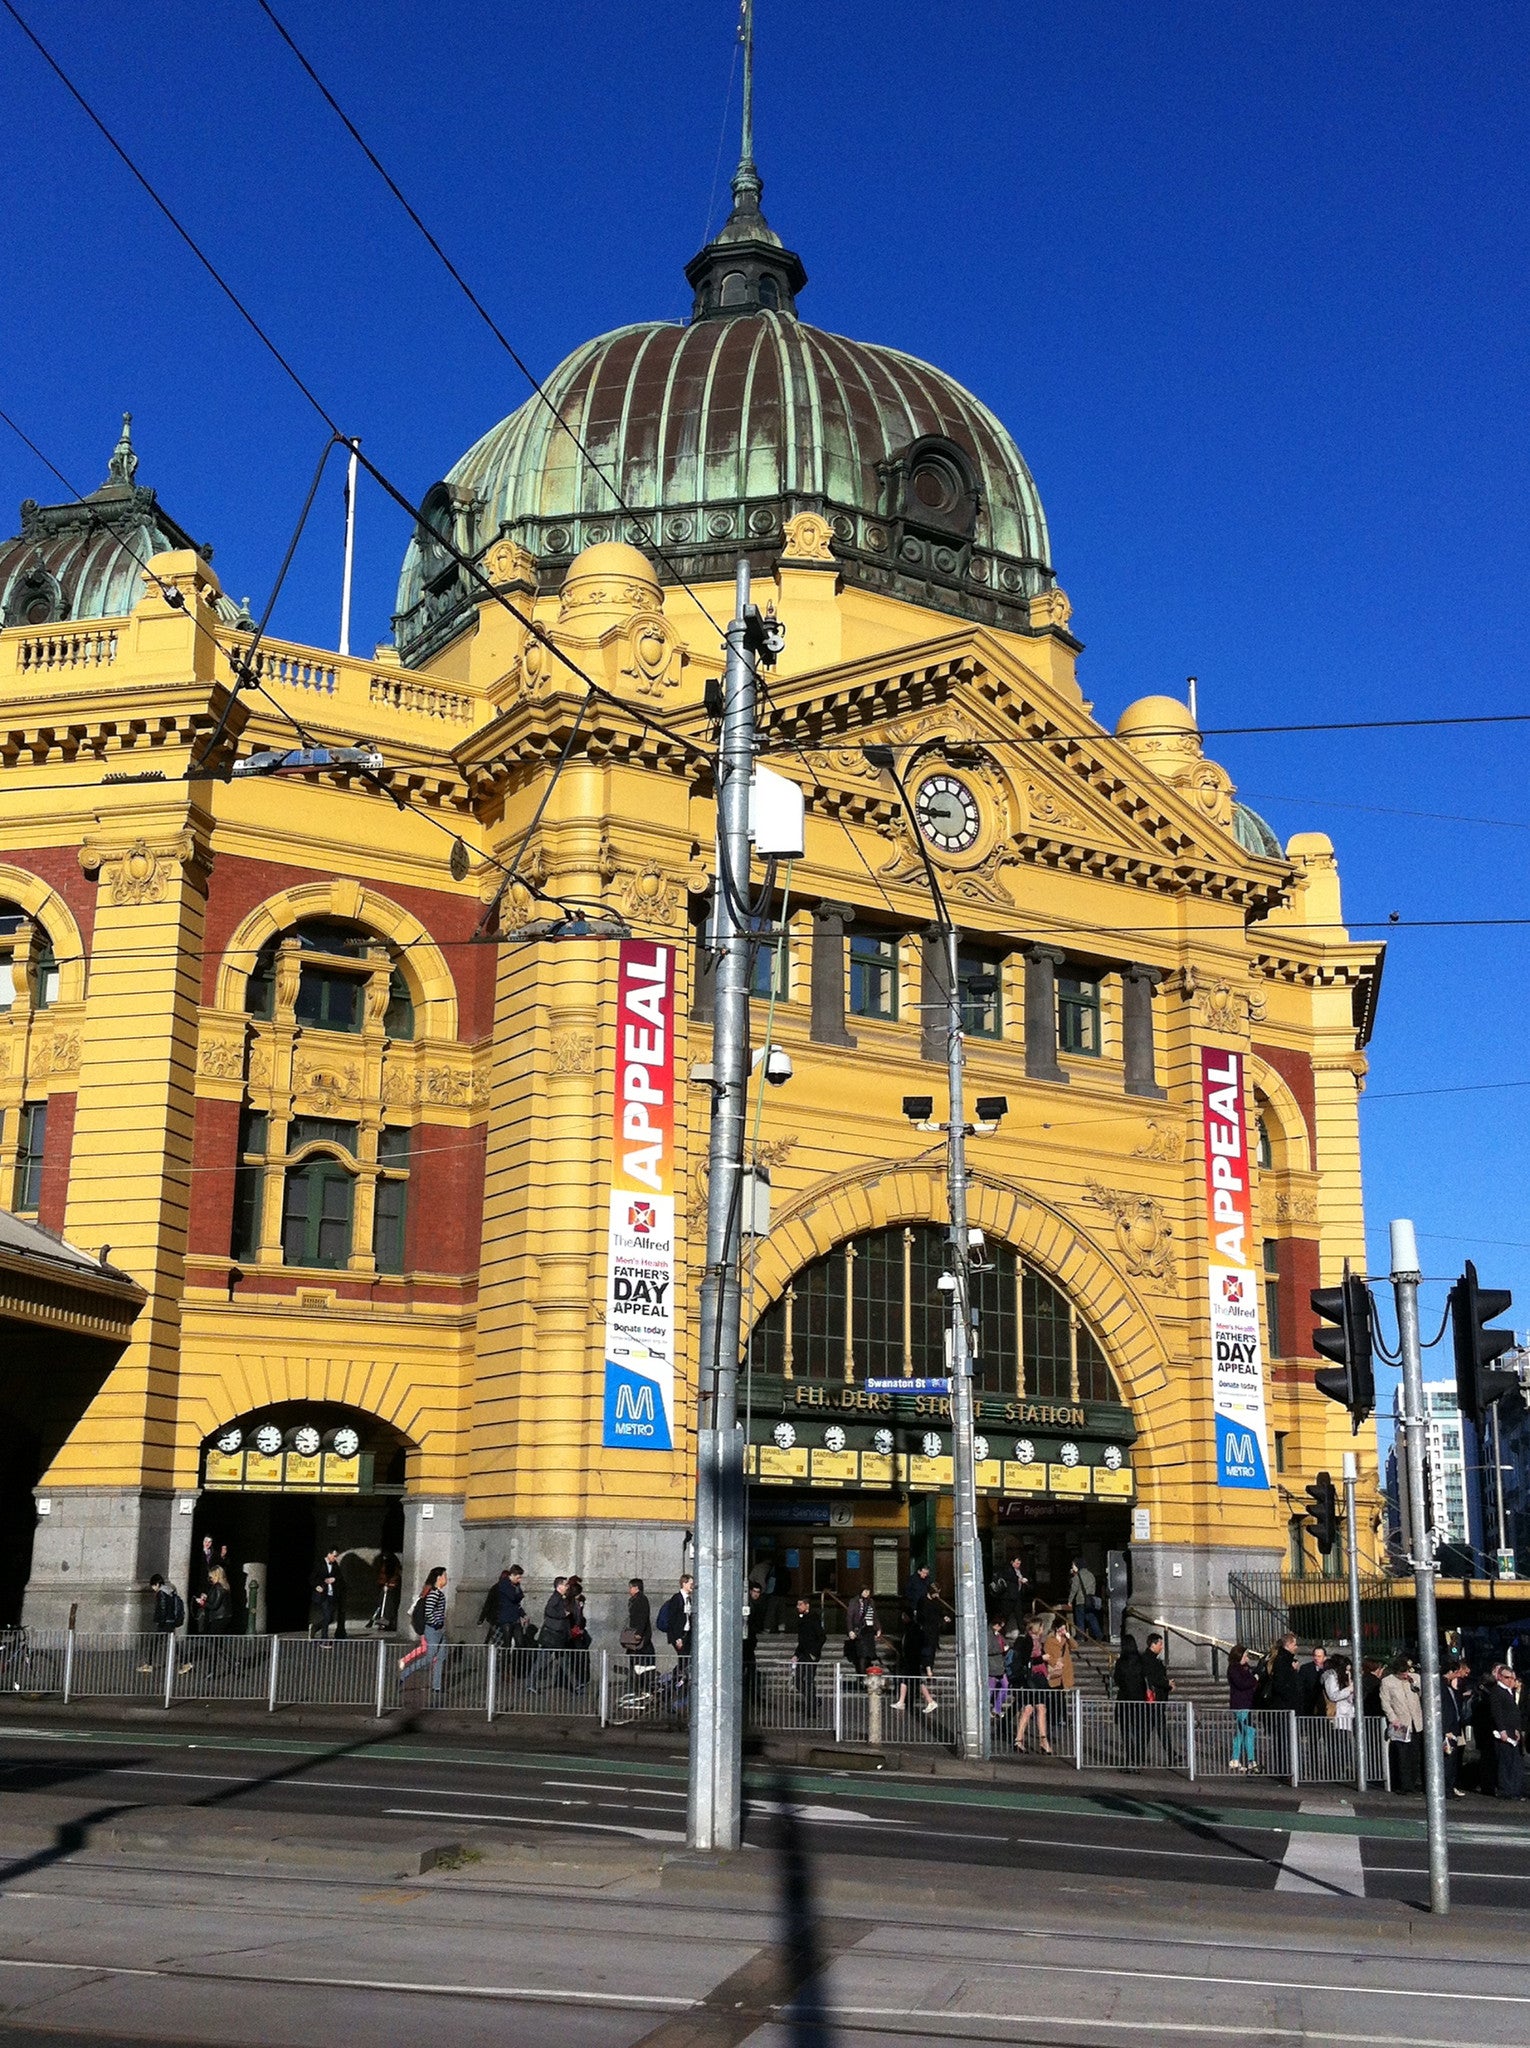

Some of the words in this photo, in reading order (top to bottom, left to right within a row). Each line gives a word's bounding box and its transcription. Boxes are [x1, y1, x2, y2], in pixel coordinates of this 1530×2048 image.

[623, 947, 667, 1192] APPEAL
[1207, 1054, 1246, 1266] APPEAL
[641, 1256, 668, 1268] Health
[613, 1266, 670, 1281] FATHER'S
[613, 1277, 670, 1304] DAY
[613, 1302, 669, 1318] APPEAL
[613, 1323, 642, 1334] Donate
[643, 1324, 667, 1337] today
[1215, 1331, 1257, 1343] FATHER'S
[1216, 1341, 1257, 1363] DAY
[1217, 1362, 1259, 1375] APPEAL
[868, 1377, 914, 1389] Swanston
[915, 1377, 926, 1389] St
[795, 1385, 892, 1411] FLINDERS
[915, 1394, 984, 1418] STRT
[1005, 1402, 1085, 1426] STATION
[615, 1421, 654, 1436] METRO
[1225, 1465, 1255, 1477] METRO
